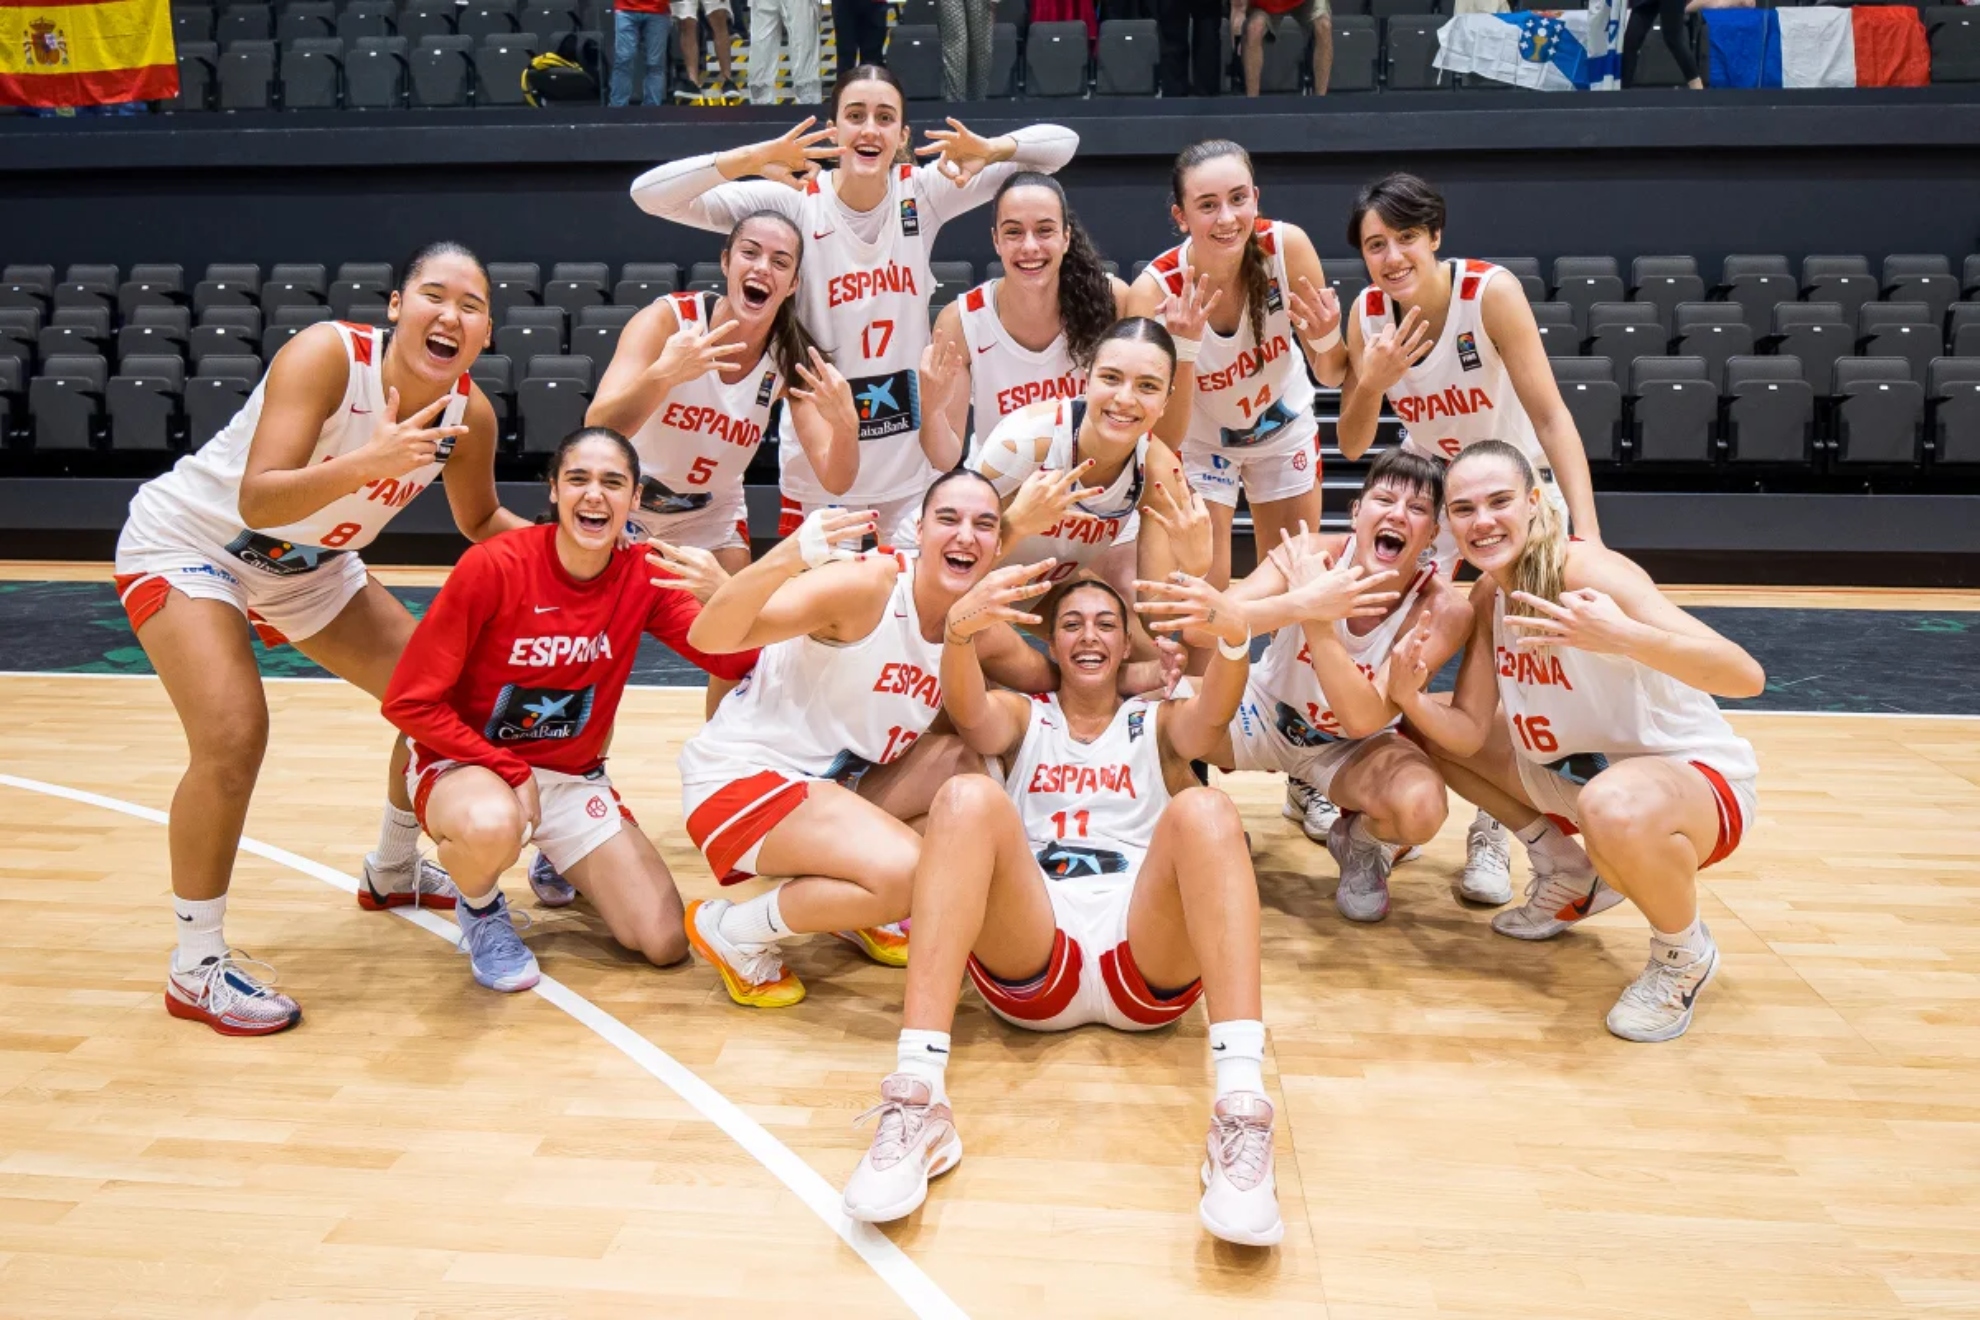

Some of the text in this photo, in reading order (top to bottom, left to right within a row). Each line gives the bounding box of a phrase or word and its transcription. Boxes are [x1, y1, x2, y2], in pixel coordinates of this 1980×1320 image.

[828, 259, 918, 308] ESPAÑA
[861, 320, 893, 359] 17
[1236, 383, 1272, 420] 14
[1391, 384, 1494, 423] SPAÑA
[858, 417, 910, 437] aixaBank
[686, 456, 719, 485] 5
[319, 522, 363, 549] 8
[1512, 712, 1560, 753] 16
[1027, 763, 1137, 799] ESPAÑA
[1050, 809, 1090, 839] 11
